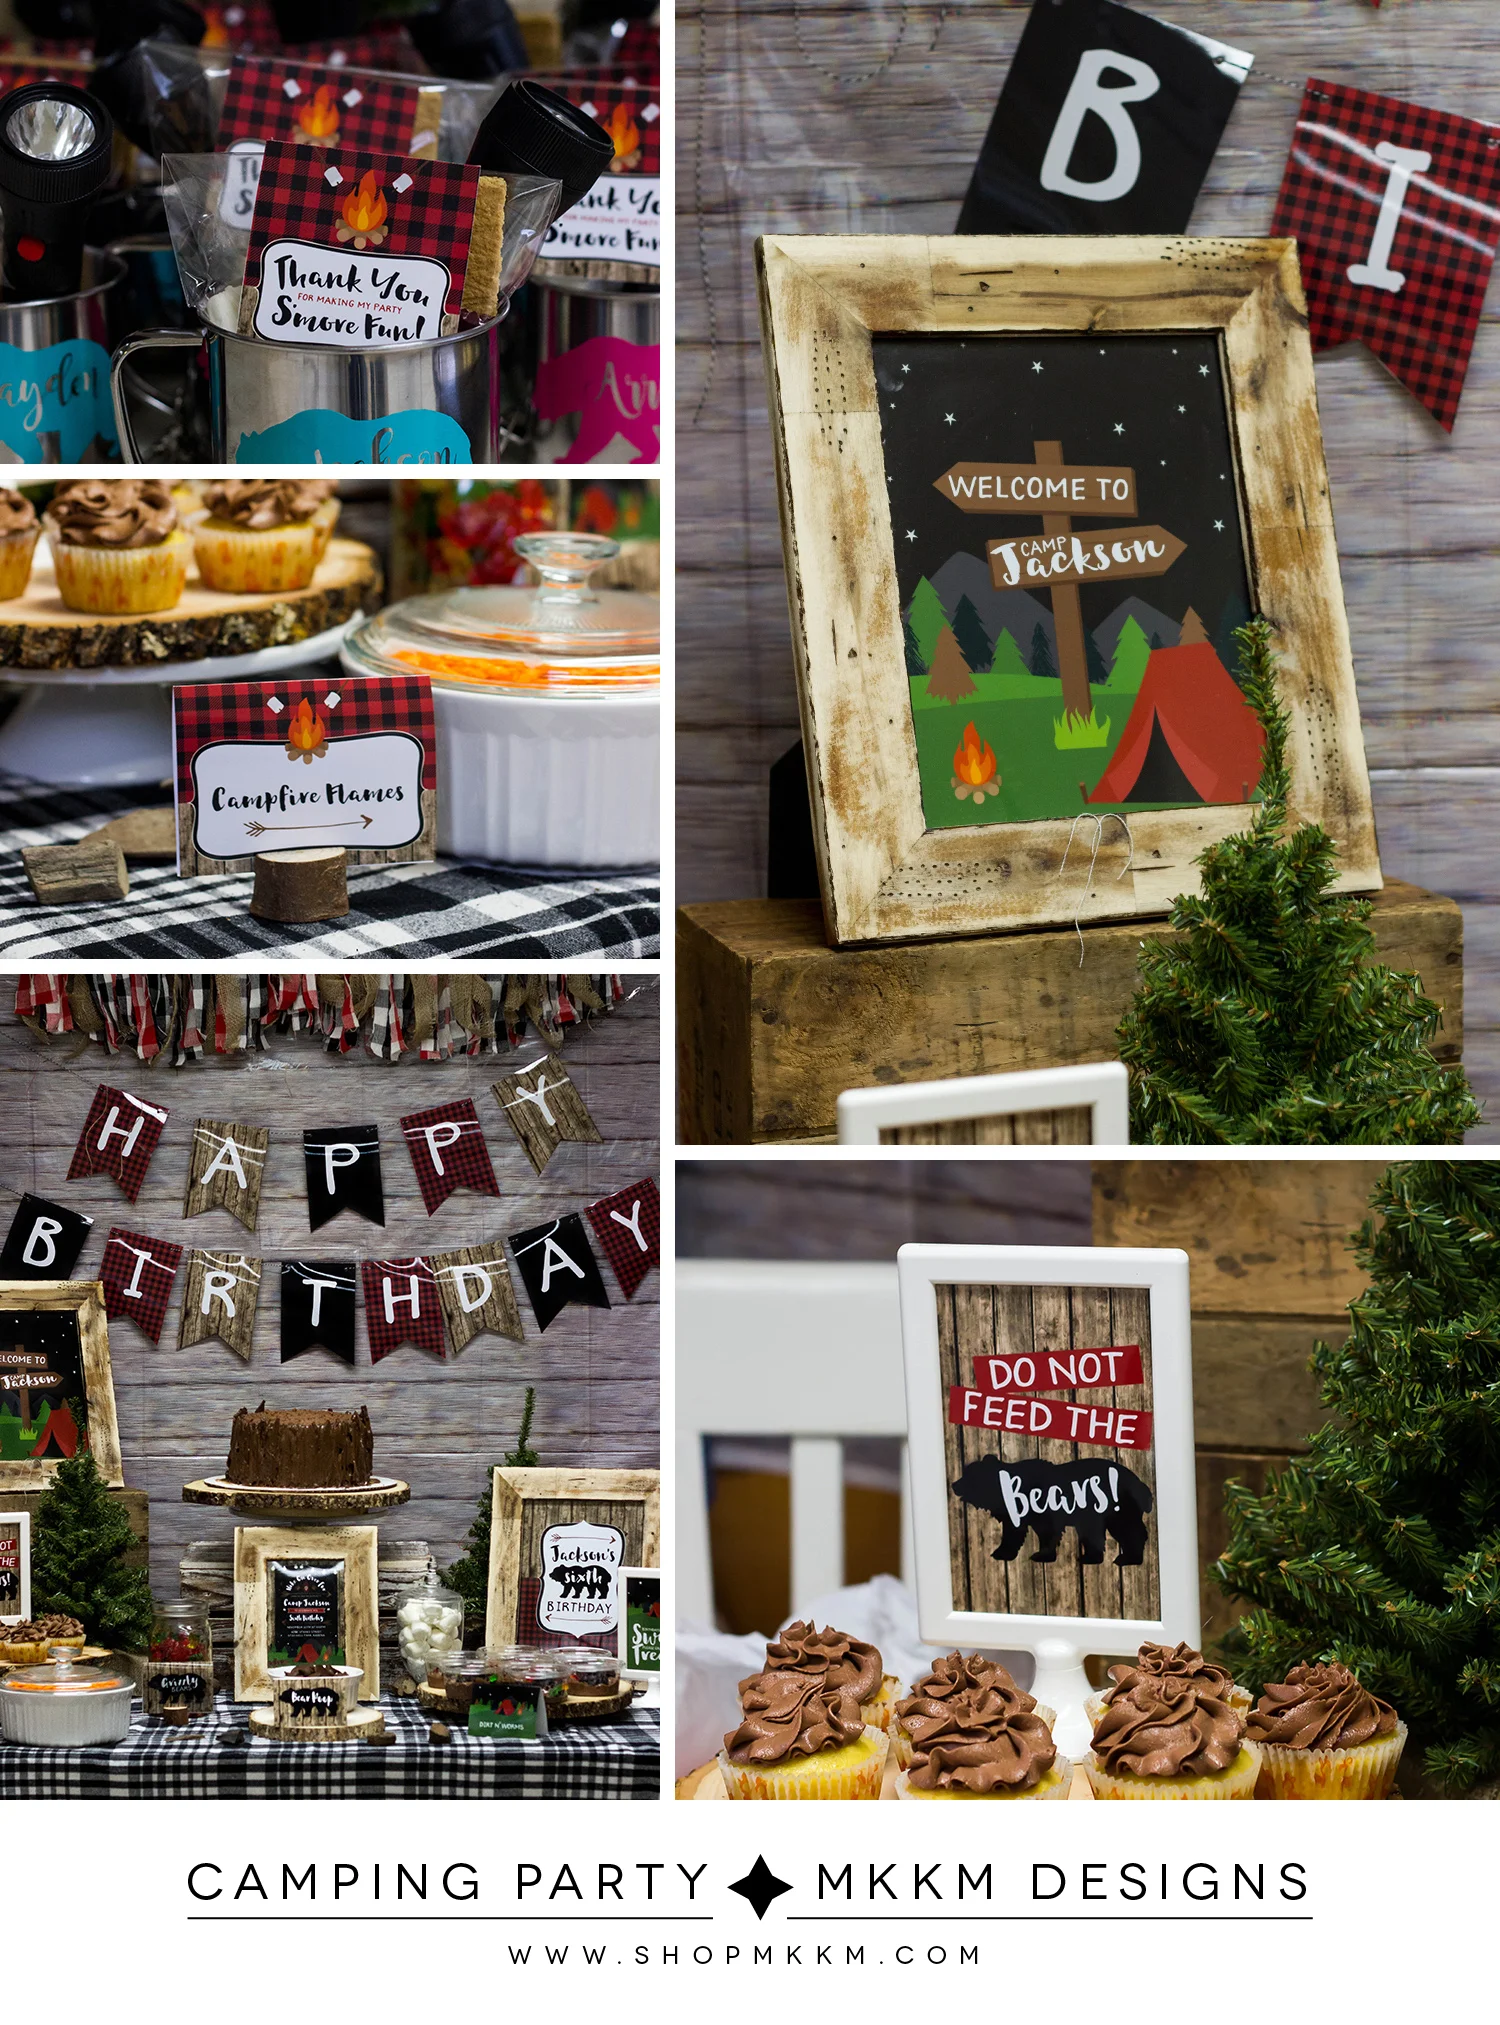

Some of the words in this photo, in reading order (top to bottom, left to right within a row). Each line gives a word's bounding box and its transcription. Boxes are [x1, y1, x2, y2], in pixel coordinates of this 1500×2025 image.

[273, 254, 363, 293] Thank
[371, 268, 430, 307] You
[297, 292, 314, 302] FOR
[316, 295, 355, 308] MAKING
[357, 301, 372, 310] MY
[373, 303, 403, 315] PARTY
[364, 313, 426, 342] Fun!
[948, 475, 1086, 500] WELCOME
[1096, 477, 1129, 501] TO
[1020, 536, 1067, 557] CAMP
[990, 536, 1166, 586] Jackson
[212, 784, 321, 813] Campfire
[325, 783, 404, 805] Flames
[34, 1356, 46, 1364] TO
[988, 1357, 1036, 1391] DO
[1048, 1351, 1124, 1385] NOT
[0, 1374, 58, 1390] Jackson
[963, 1390, 1053, 1432] FEED
[1066, 1405, 1139, 1444] THE
[999, 1467, 1121, 1528] Bears!
[550, 1544, 616, 1563] Jackson's
[564, 1567, 603, 1585] sixth
[283, 1598, 302, 1607] Camp
[303, 1598, 331, 1607] Jackson
[547, 1601, 613, 1614] BIRTHDAY
[291, 1691, 311, 1703] Bear
[501, 1723, 524, 1731] WORMS
